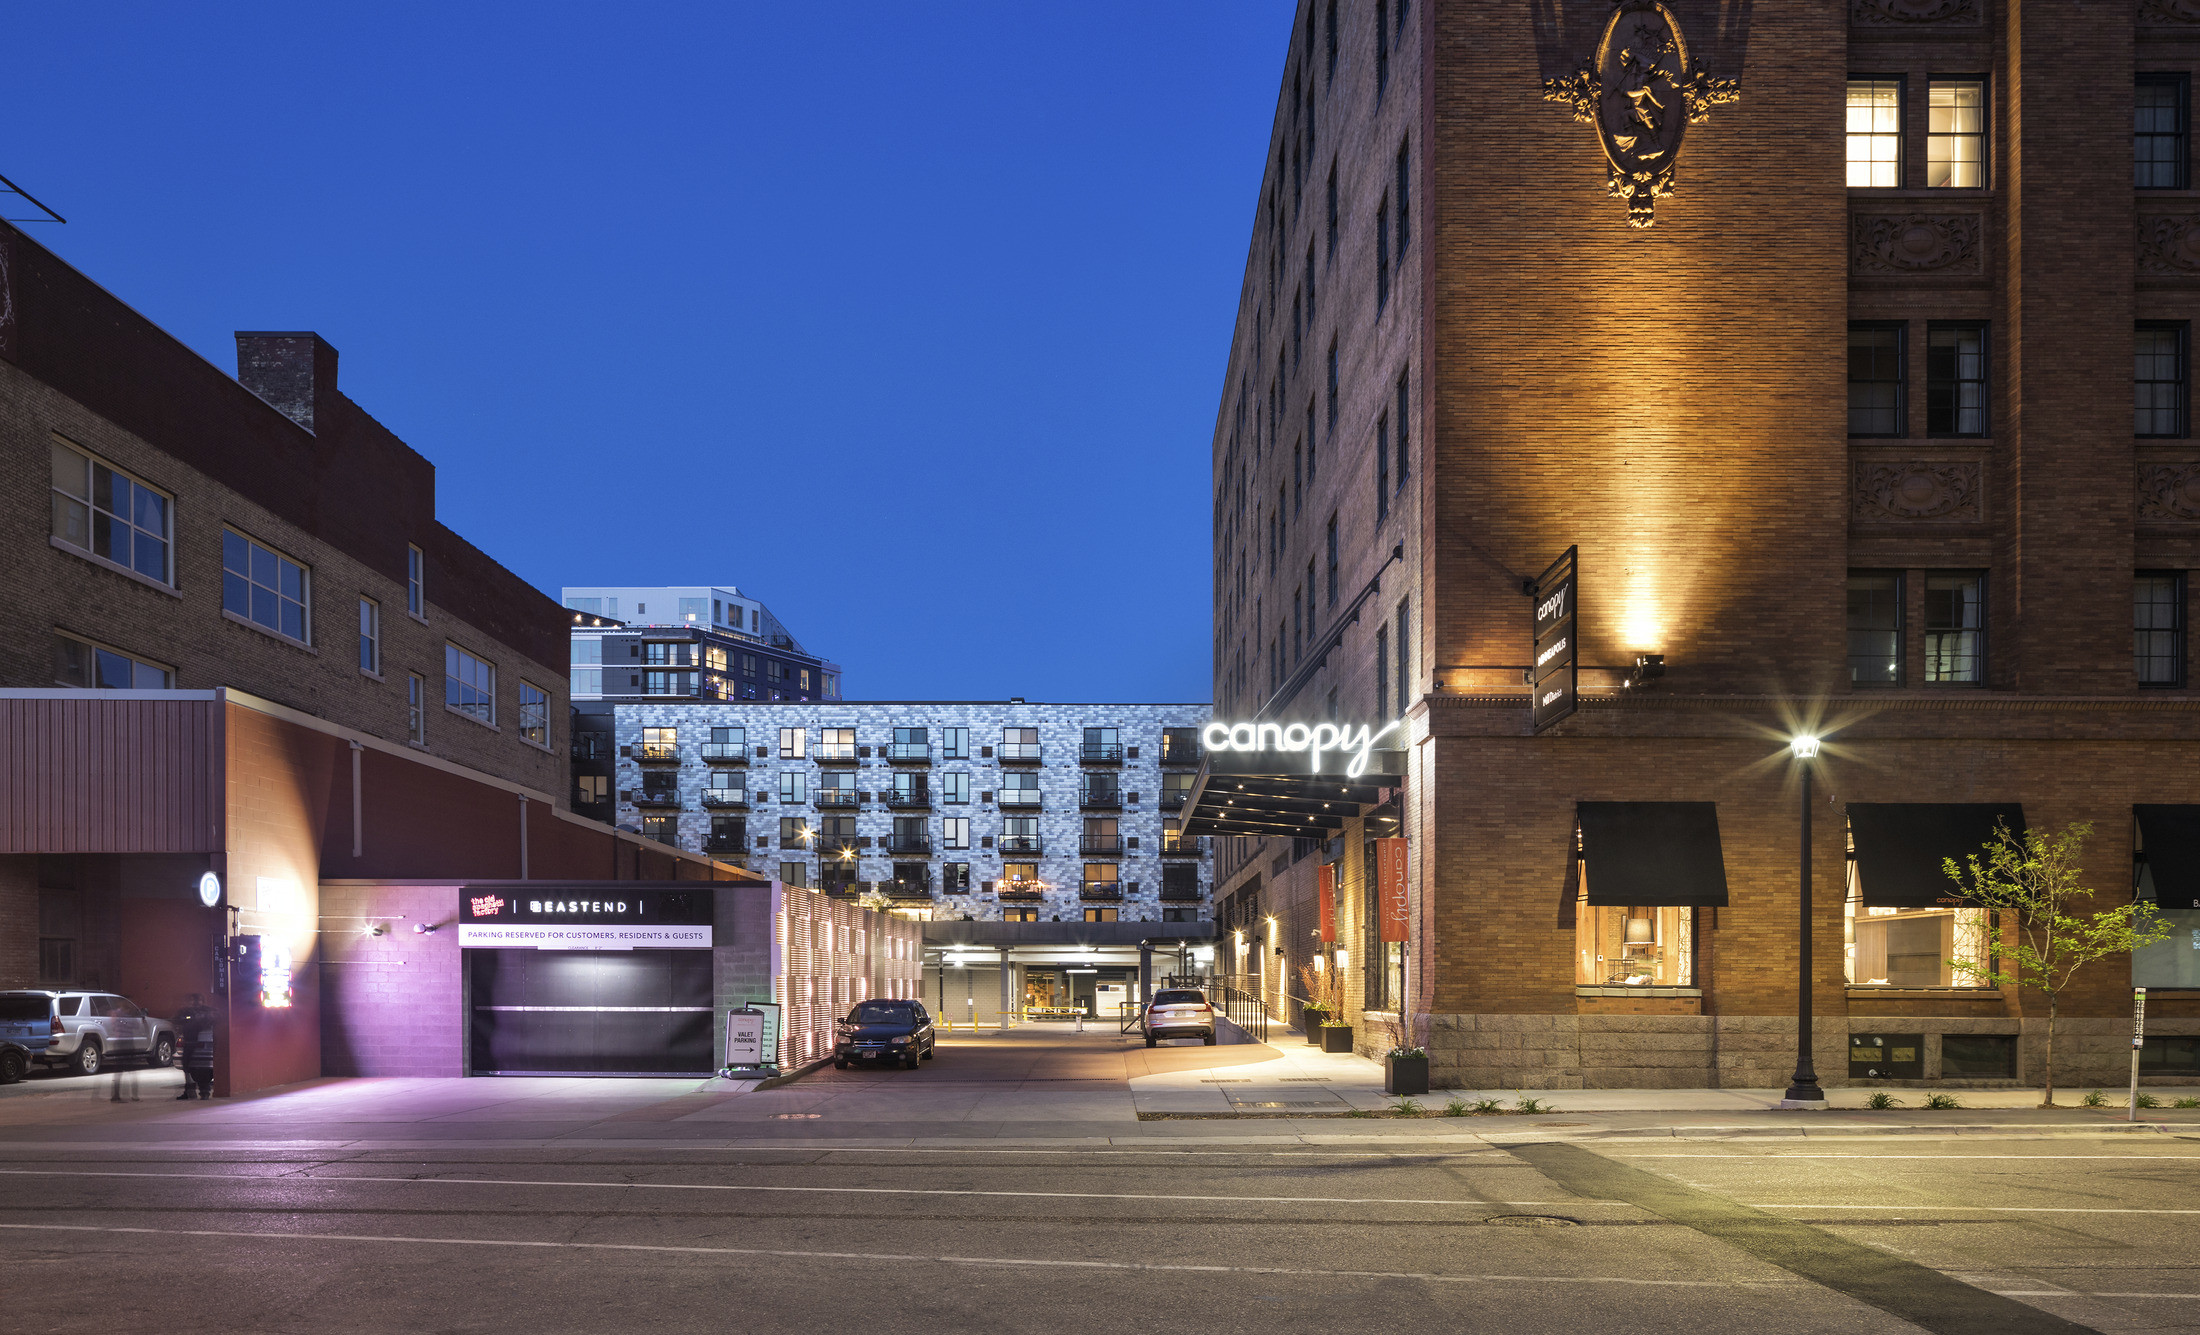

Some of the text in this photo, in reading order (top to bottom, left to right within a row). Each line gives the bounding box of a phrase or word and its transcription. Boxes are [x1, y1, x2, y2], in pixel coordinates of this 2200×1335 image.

[1537, 582, 1569, 621] canopy
[1202, 719, 1401, 777] canopy
[1390, 847, 1409, 929] canopy
[505, 931, 546, 939] RESERVED
[566, 932, 617, 940] CUSTOMERS,
[672, 932, 703, 940] GUESTS
